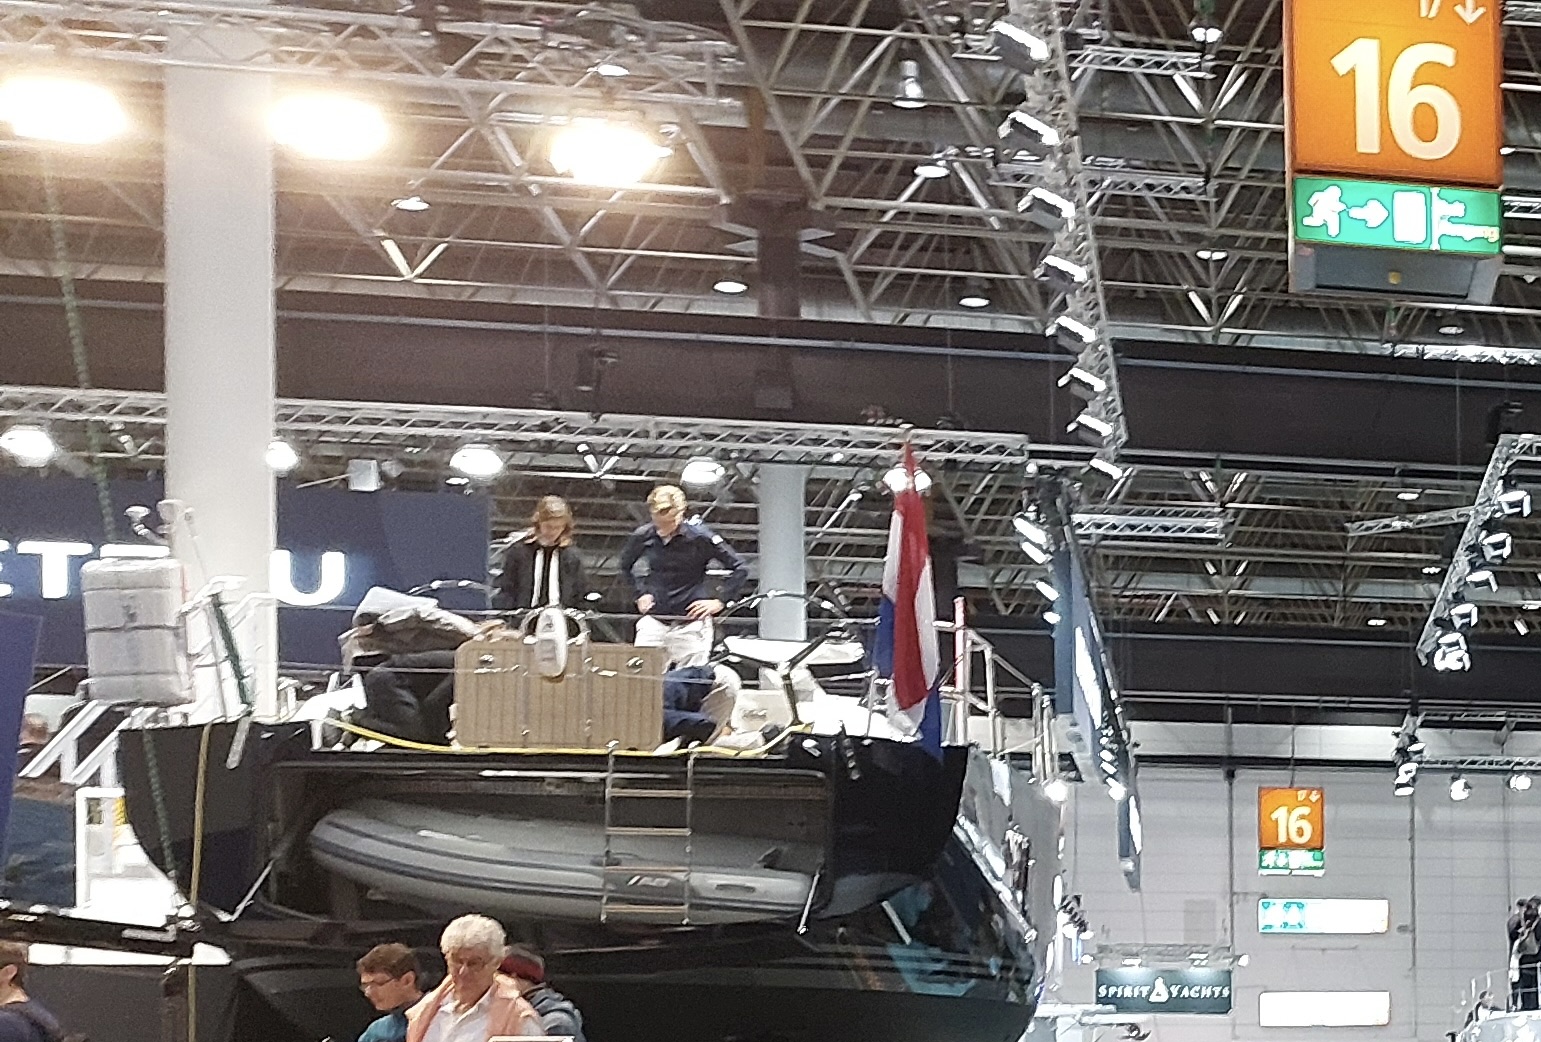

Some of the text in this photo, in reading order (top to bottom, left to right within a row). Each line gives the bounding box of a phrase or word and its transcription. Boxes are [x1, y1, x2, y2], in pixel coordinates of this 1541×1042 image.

[1330, 37, 1462, 160] 16
[1270, 805, 1313, 844] 16
[1097, 984, 1231, 999] SPIRIT YACHTS
